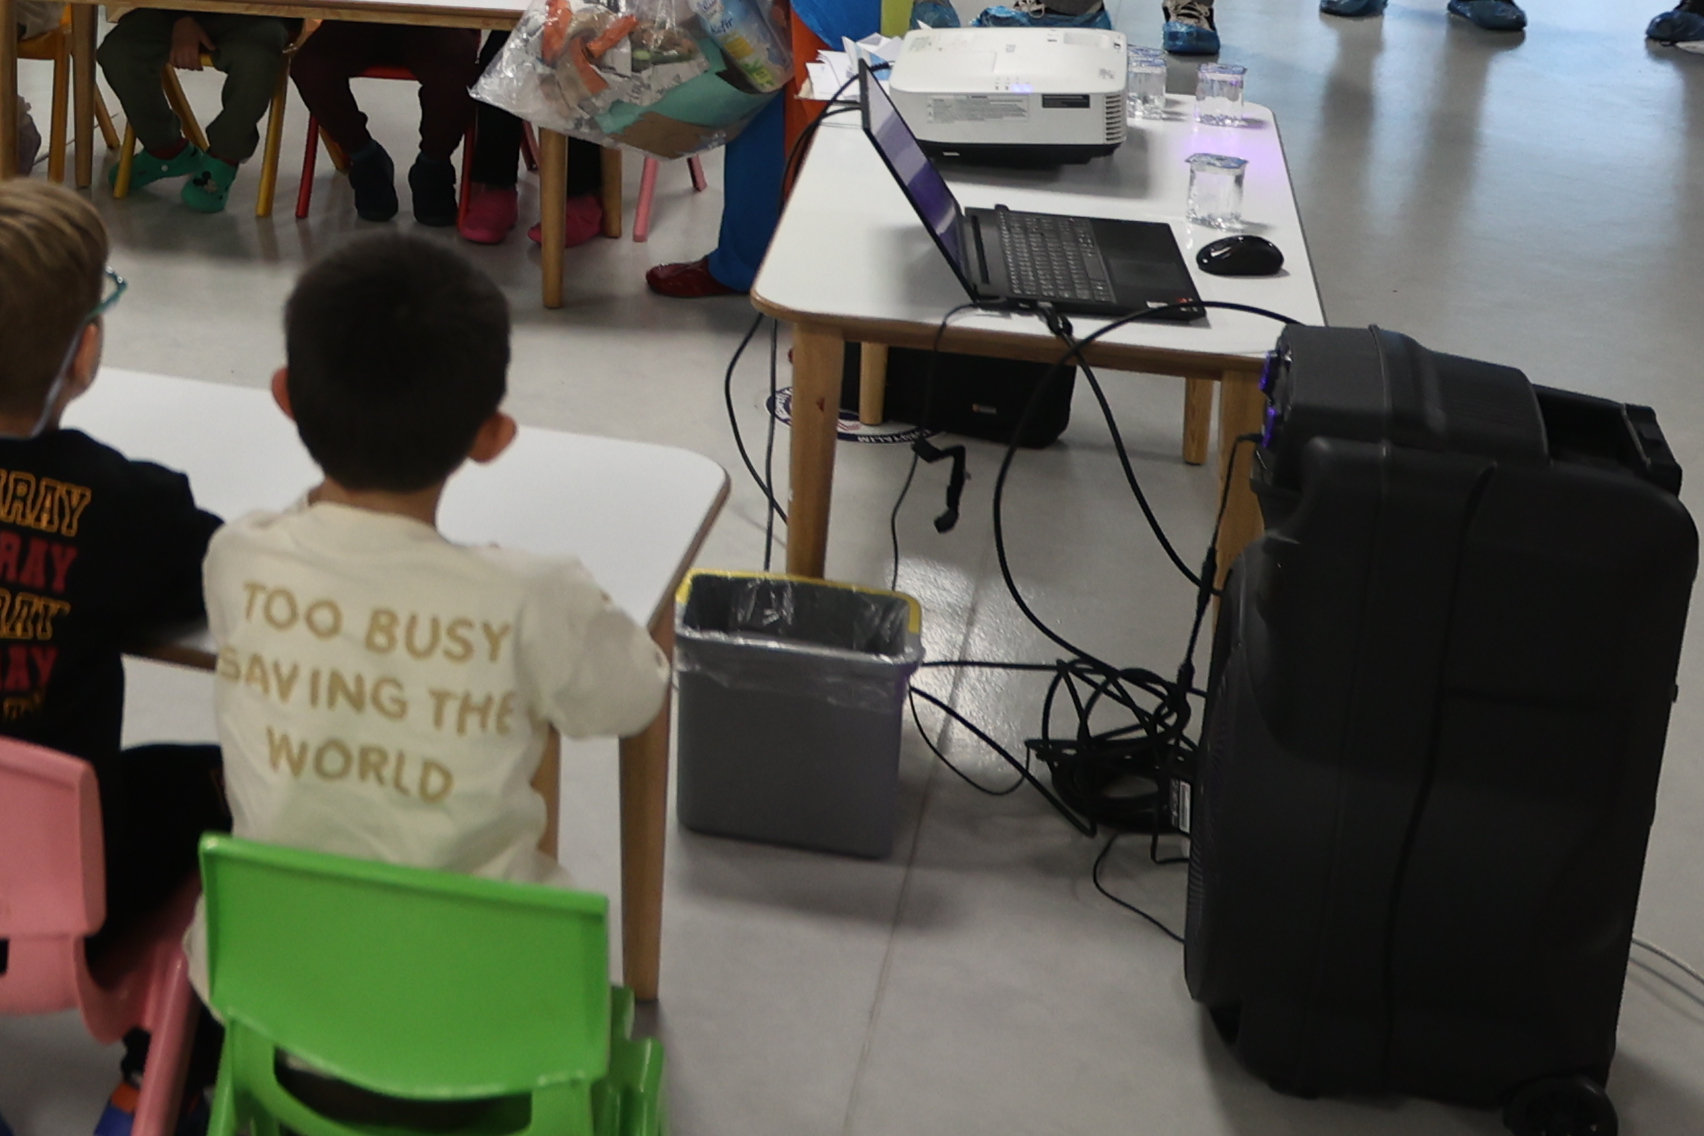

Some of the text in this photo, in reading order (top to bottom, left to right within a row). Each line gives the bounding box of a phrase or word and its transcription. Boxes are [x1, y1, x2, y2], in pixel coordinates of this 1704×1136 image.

[242, 580, 512, 665] TOO BUSY
[216, 644, 516, 738] SAVING THE
[265, 725, 455, 804] WORLD
